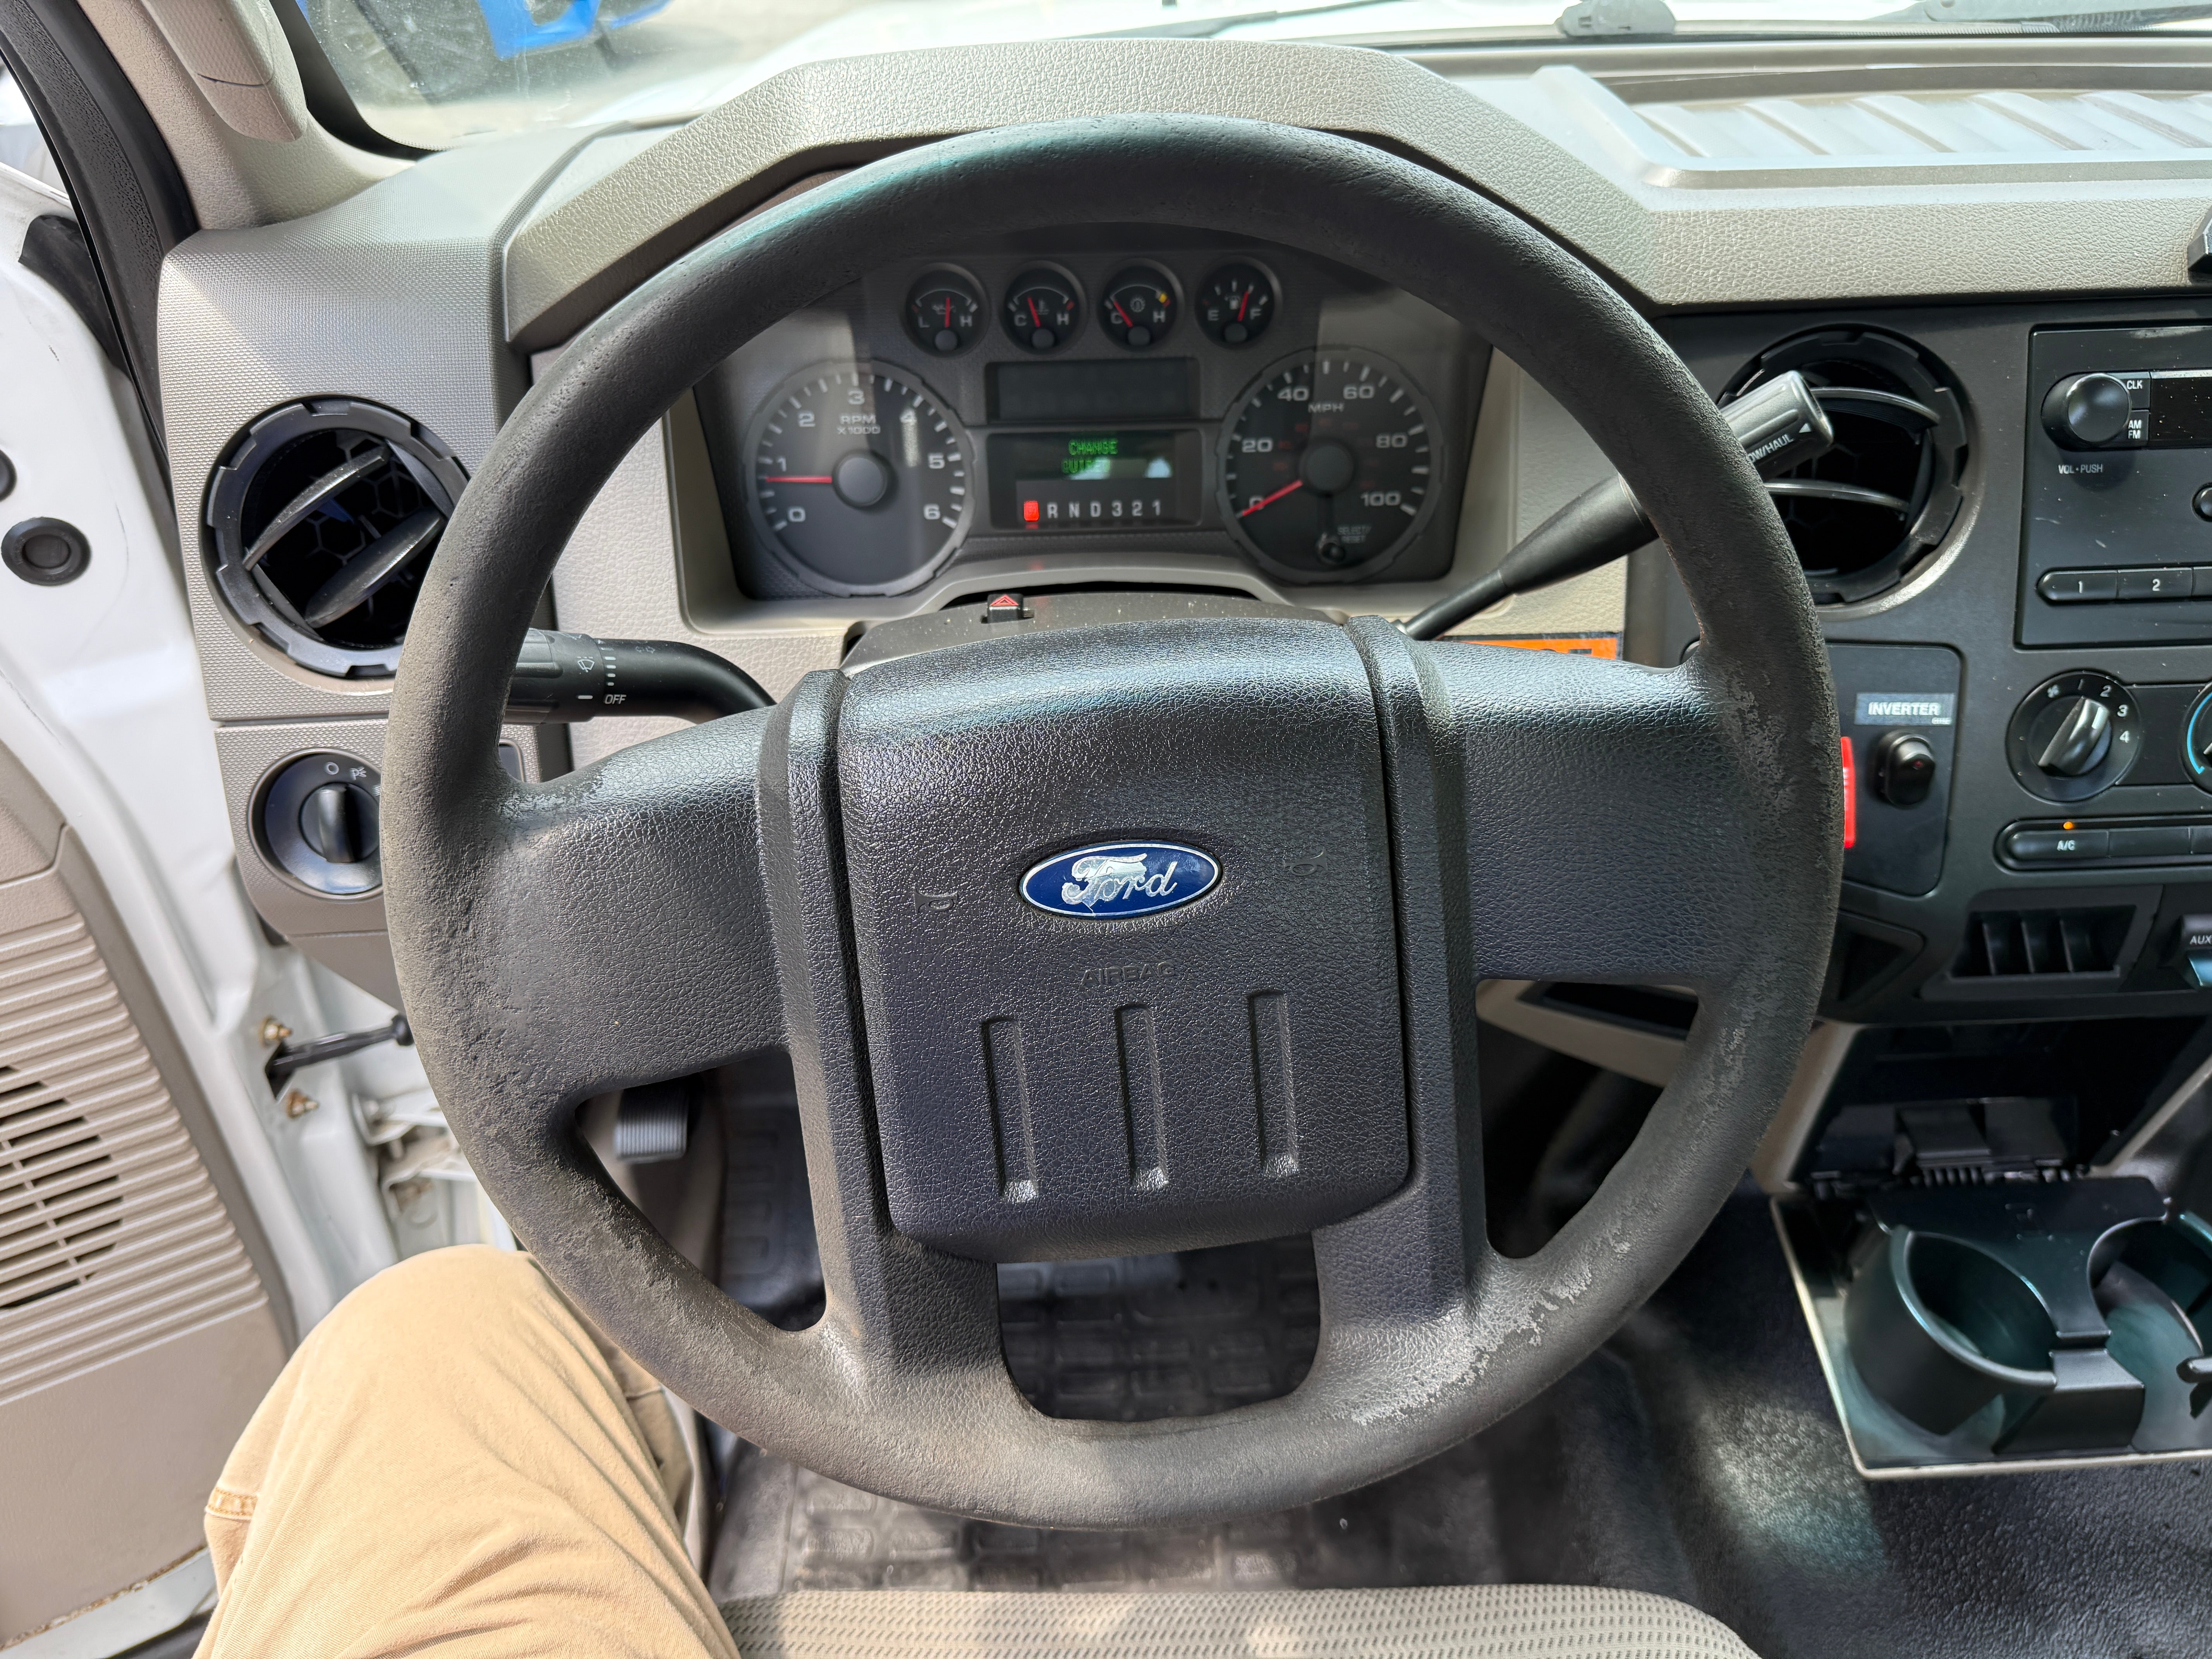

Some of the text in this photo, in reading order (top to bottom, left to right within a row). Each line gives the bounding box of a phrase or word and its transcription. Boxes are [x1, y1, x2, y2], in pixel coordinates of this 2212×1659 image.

[1014, 314, 1027, 327] C
[1056, 313, 1069, 325] H
[1111, 312, 1123, 324] C
[1153, 310, 1166, 323] H
[1208, 310, 1219, 321] E
[1250, 308, 1261, 320] F
[918, 316, 930, 328] L
[960, 315, 972, 327] H
[2126, 381, 2143, 390] CLK
[848, 389, 865, 405] 3
[1278, 387, 1309, 401] 40
[1343, 386, 1375, 399] 60
[1308, 402, 1345, 413] MPH
[798, 412, 815, 427] 2
[840, 414, 876, 424] RPM
[900, 409, 917, 423] 4
[2128, 420, 2142, 429] AM
[1376, 434, 1407, 448] 80
[2128, 430, 2141, 439] FM
[1068, 439, 1118, 455] CHANGE
[1242, 438, 1273, 453] 20
[1746, 434, 1795, 463] OW/HAUL
[777, 456, 787, 472] 1
[928, 453, 945, 469] 5
[2058, 464, 2103, 474] VOL PUSH
[1360, 491, 1401, 506] 100
[788, 506, 805, 522] 0
[923, 504, 940, 520] 6
[1047, 503, 1058, 519] R
[1069, 502, 1080, 518] N
[1090, 502, 1101, 517] D
[1112, 501, 1123, 517] 3
[1132, 501, 1142, 516] 2
[1152, 500, 1161, 516] 1
[2078, 581, 2083, 593] 1
[2152, 579, 2161, 591] 2
[2100, 685, 2112, 697] 2
[604, 694, 627, 704] OFF
[1868, 702, 1941, 715] INVERTER
[2117, 705, 2128, 717] 3
[2119, 731, 2130, 743] 4
[2057, 840, 2076, 851] A/C
[1061, 853, 1178, 907] Ford
[1082, 962, 1175, 986] AIRBAG
